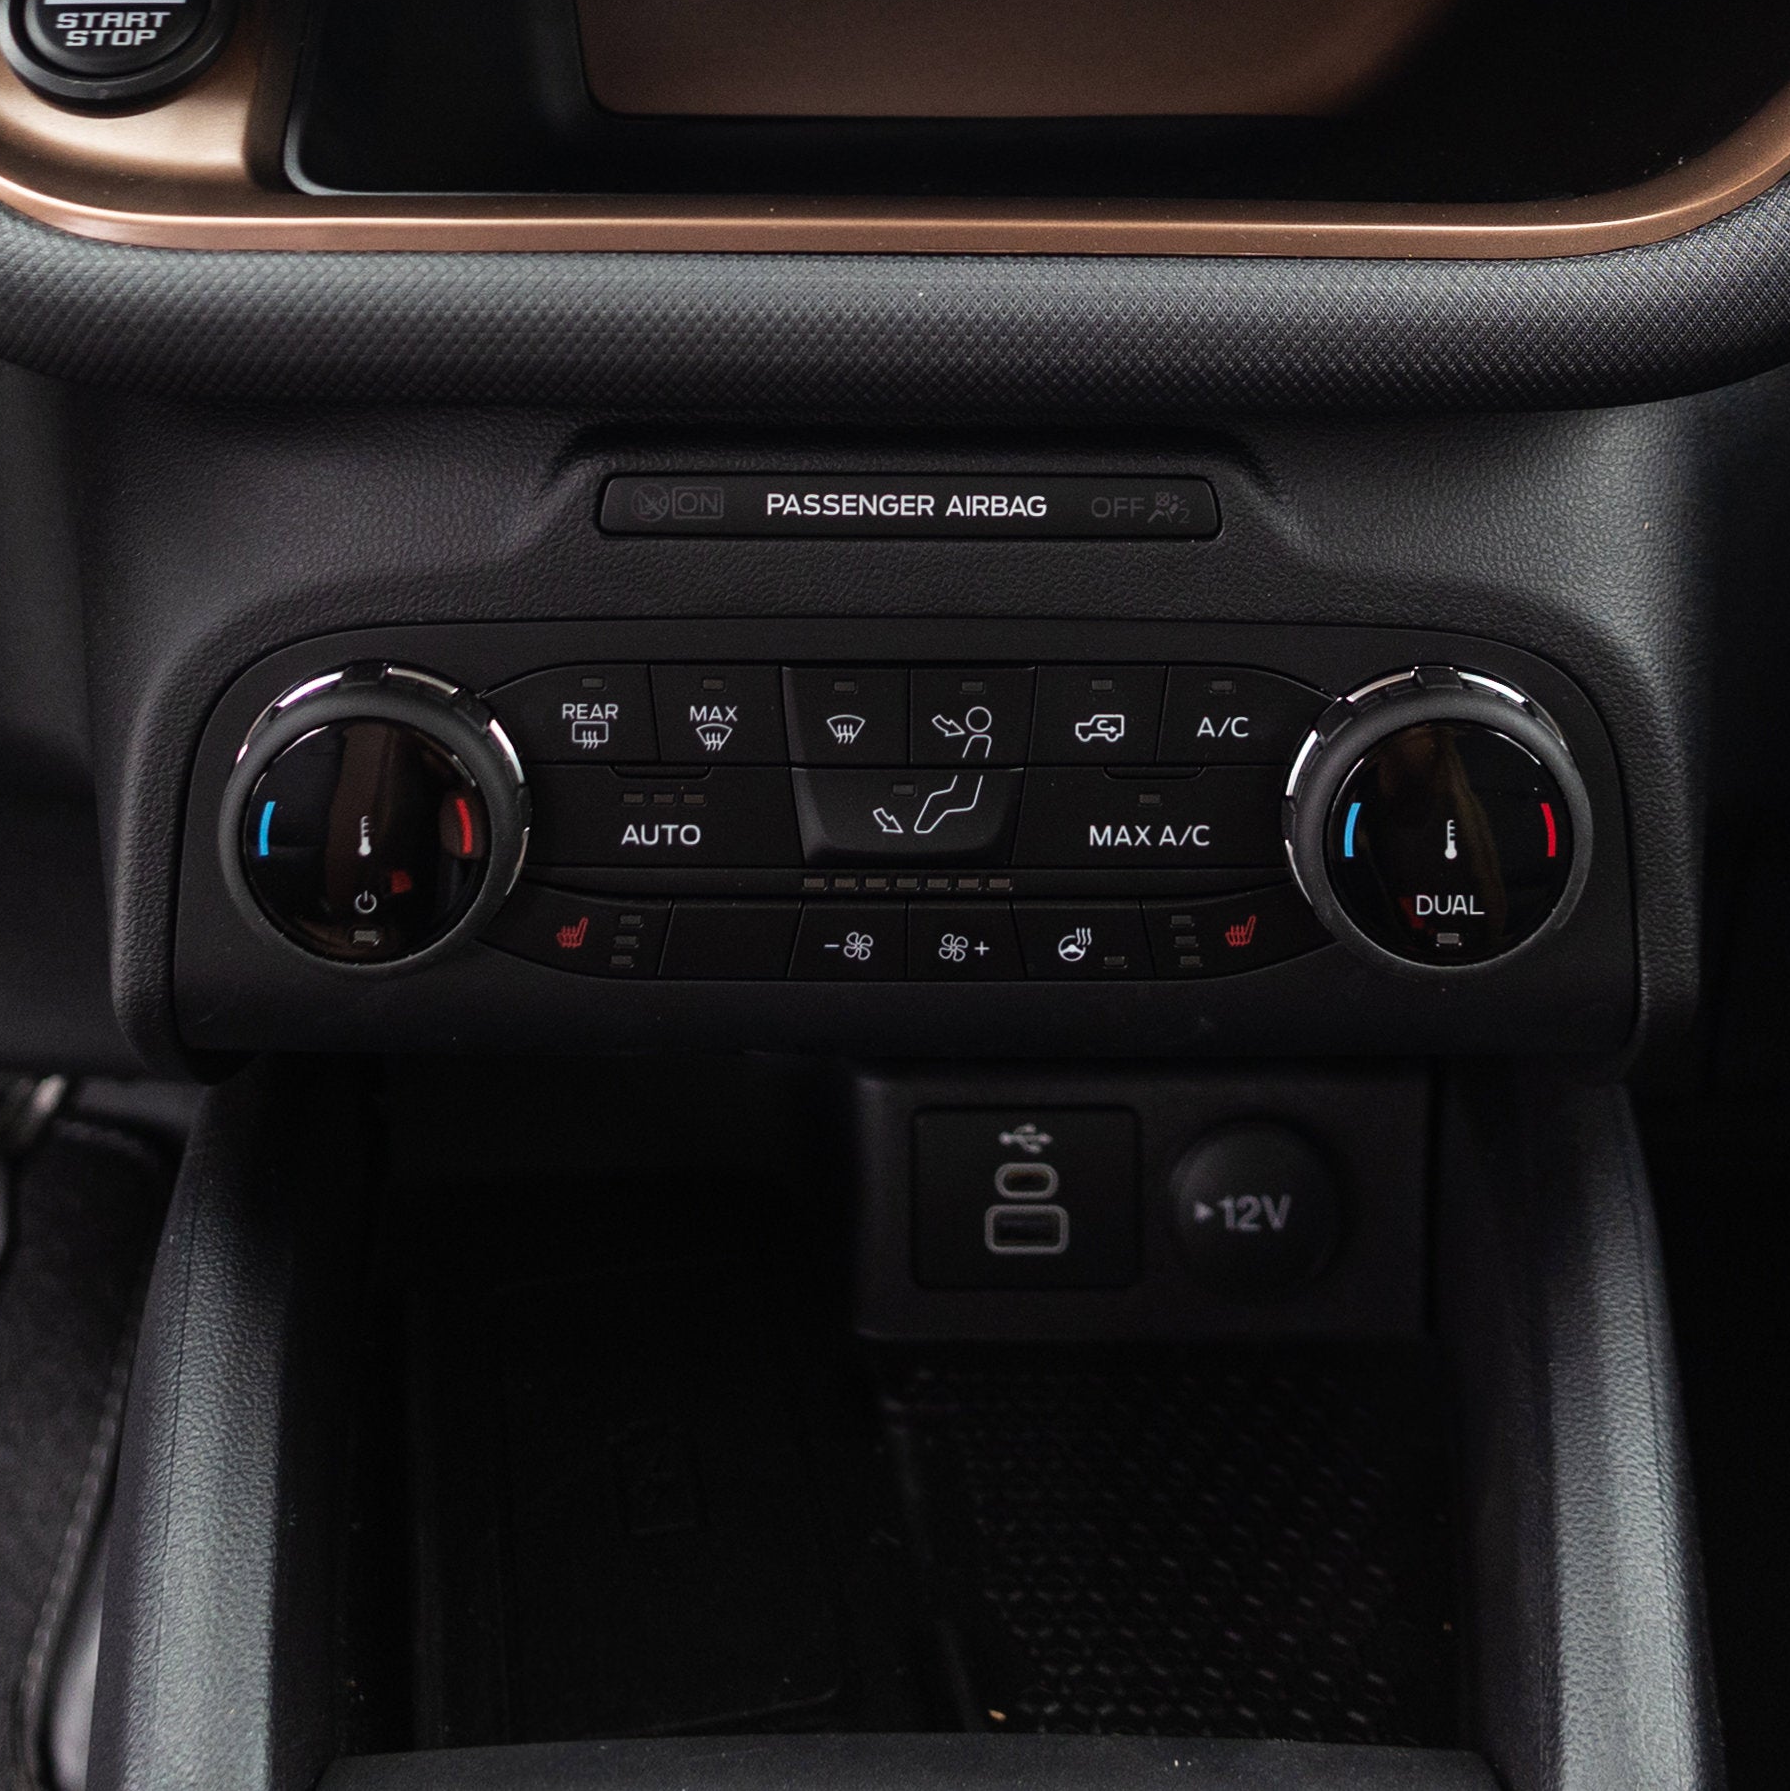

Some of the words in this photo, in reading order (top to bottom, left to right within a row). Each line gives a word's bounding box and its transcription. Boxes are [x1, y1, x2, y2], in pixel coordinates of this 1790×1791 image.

[55, 11, 172, 30] START
[64, 29, 158, 47] STOP
[678, 492, 718, 513] ON
[767, 492, 935, 517] PASSENGER
[945, 494, 1048, 518] AIRBAG
[1091, 496, 1145, 518] OFF
[562, 703, 619, 720] REAR
[689, 705, 738, 723] MAX
[1196, 716, 1249, 738] A/C
[621, 824, 702, 846] AUTO
[1089, 824, 1152, 847] MAX
[1158, 824, 1210, 847] A/C
[1415, 894, 1485, 916] DUAL
[1218, 1194, 1292, 1231] 12V
